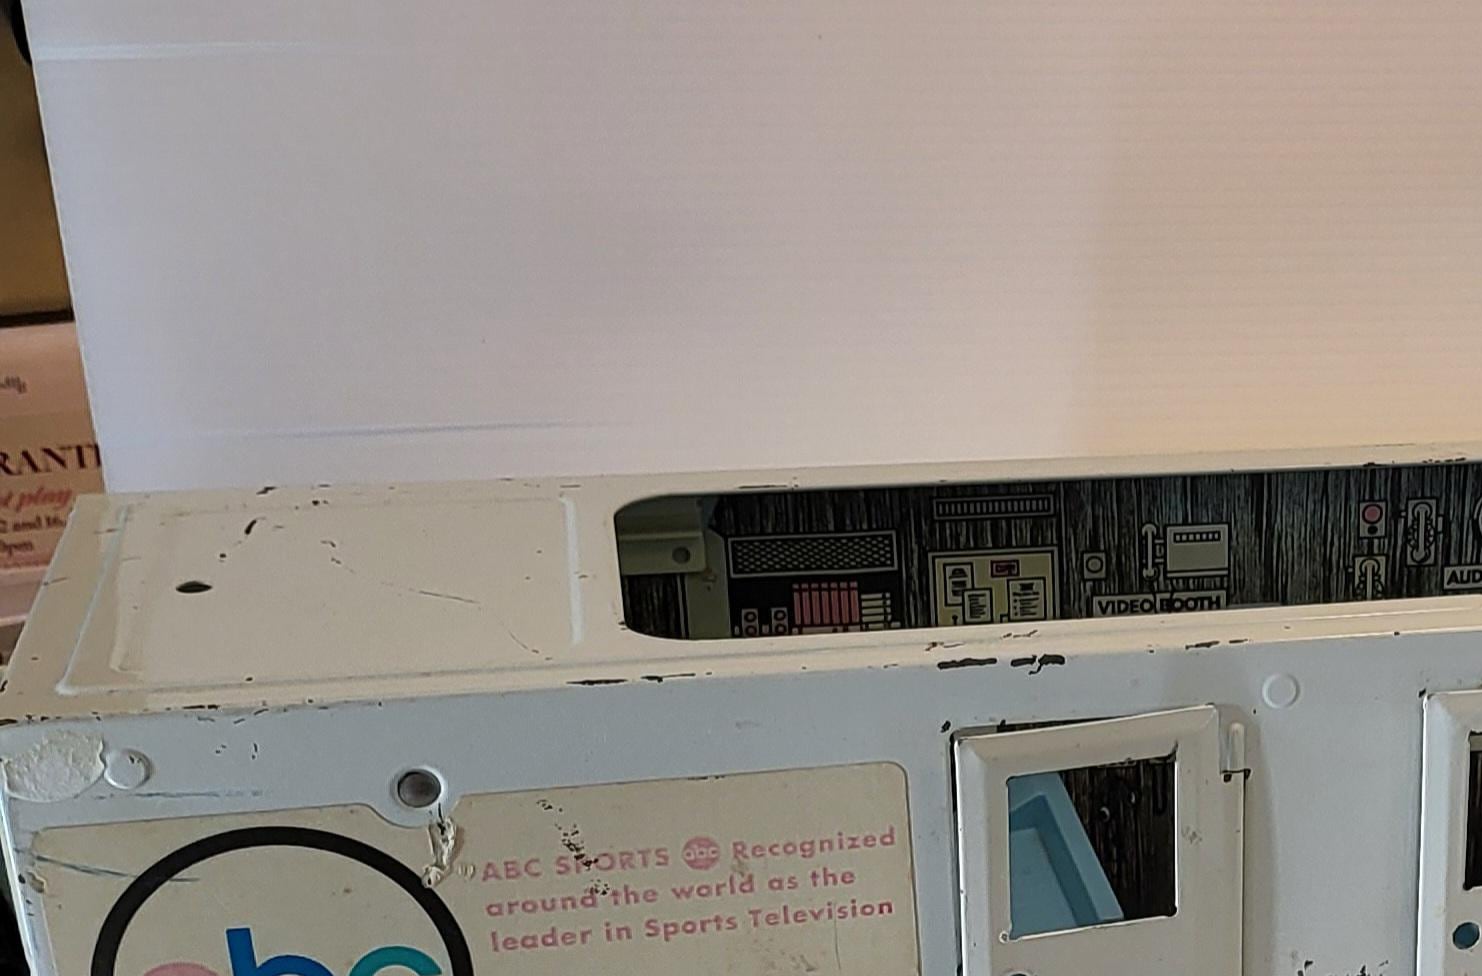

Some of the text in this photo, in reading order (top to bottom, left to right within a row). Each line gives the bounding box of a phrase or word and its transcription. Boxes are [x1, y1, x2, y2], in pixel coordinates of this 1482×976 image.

[1097, 596, 1221, 614] VIDEO BOOTH
[481, 858, 543, 882] ABC
[554, 847, 669, 876] SPORTS
[731, 826, 897, 861] Recognized
[485, 866, 856, 917] around the world as the
[490, 898, 895, 952] leader in Sports Television
